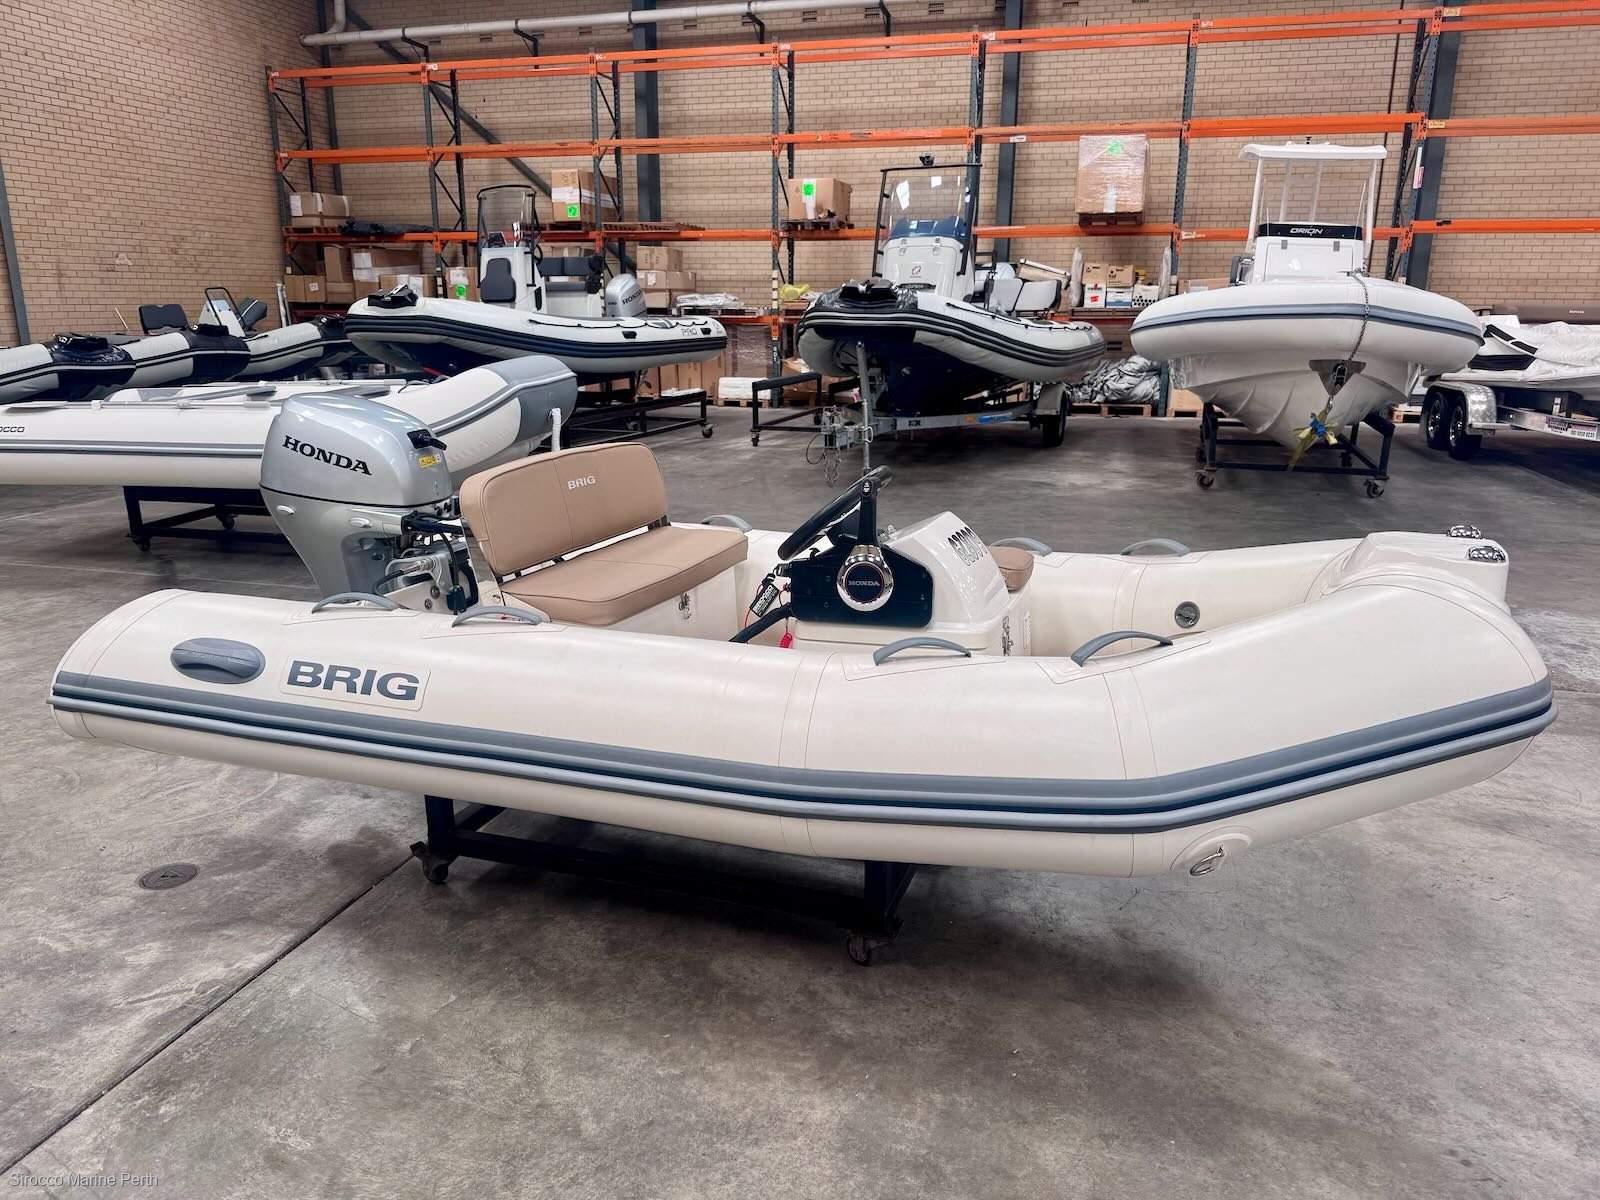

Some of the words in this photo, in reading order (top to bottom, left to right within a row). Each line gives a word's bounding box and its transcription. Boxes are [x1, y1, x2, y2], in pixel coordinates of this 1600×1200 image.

[1290, 227, 1323, 236] ORION
[282, 435, 372, 475] HONDA
[567, 475, 596, 490] BRIG
[287, 660, 419, 700] BRIG
